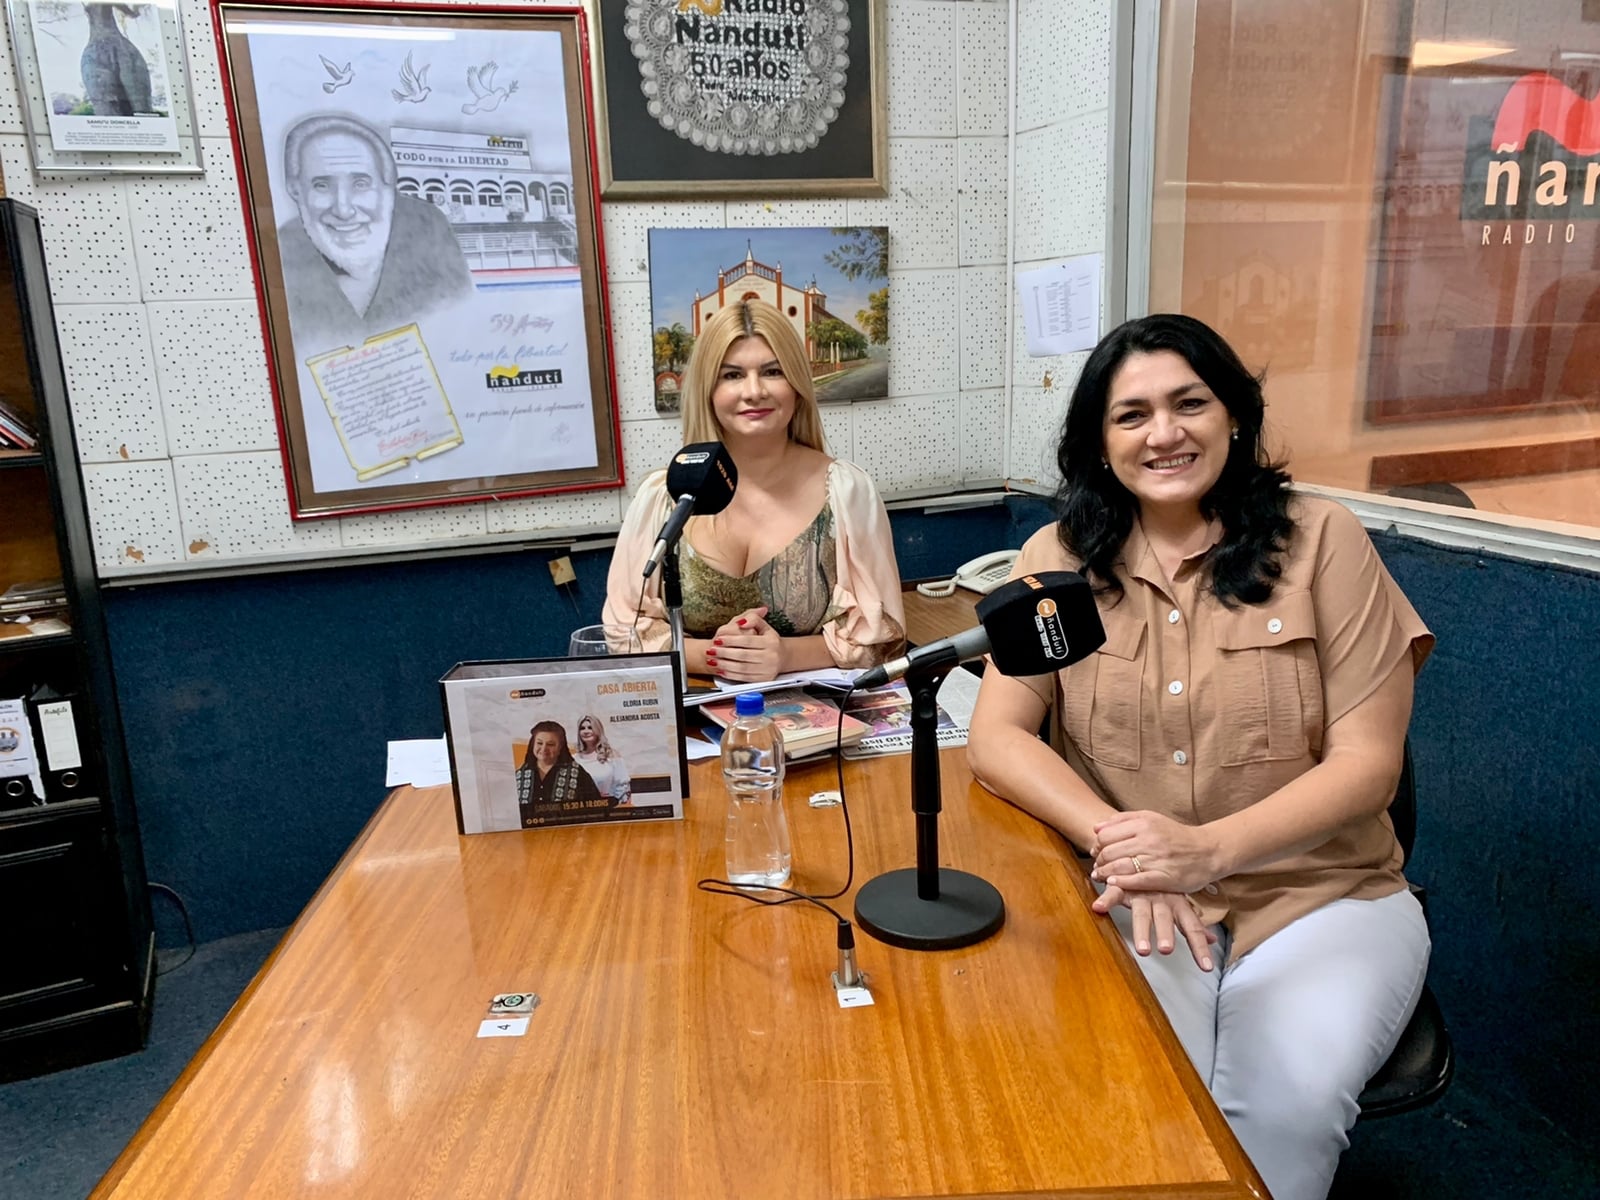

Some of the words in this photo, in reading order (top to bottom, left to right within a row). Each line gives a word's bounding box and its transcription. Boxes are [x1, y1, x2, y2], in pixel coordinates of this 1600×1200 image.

[691, 53, 720, 77] 50
[726, 49, 790, 81] años
[394, 151, 426, 161] TODO
[458, 155, 509, 166] LIBERTAD
[1481, 223, 1575, 246] RADIO
[597, 683, 620, 695] CASA
[622, 681, 657, 693] ABIERTA
[640, 713, 660, 721] ACOSTA
